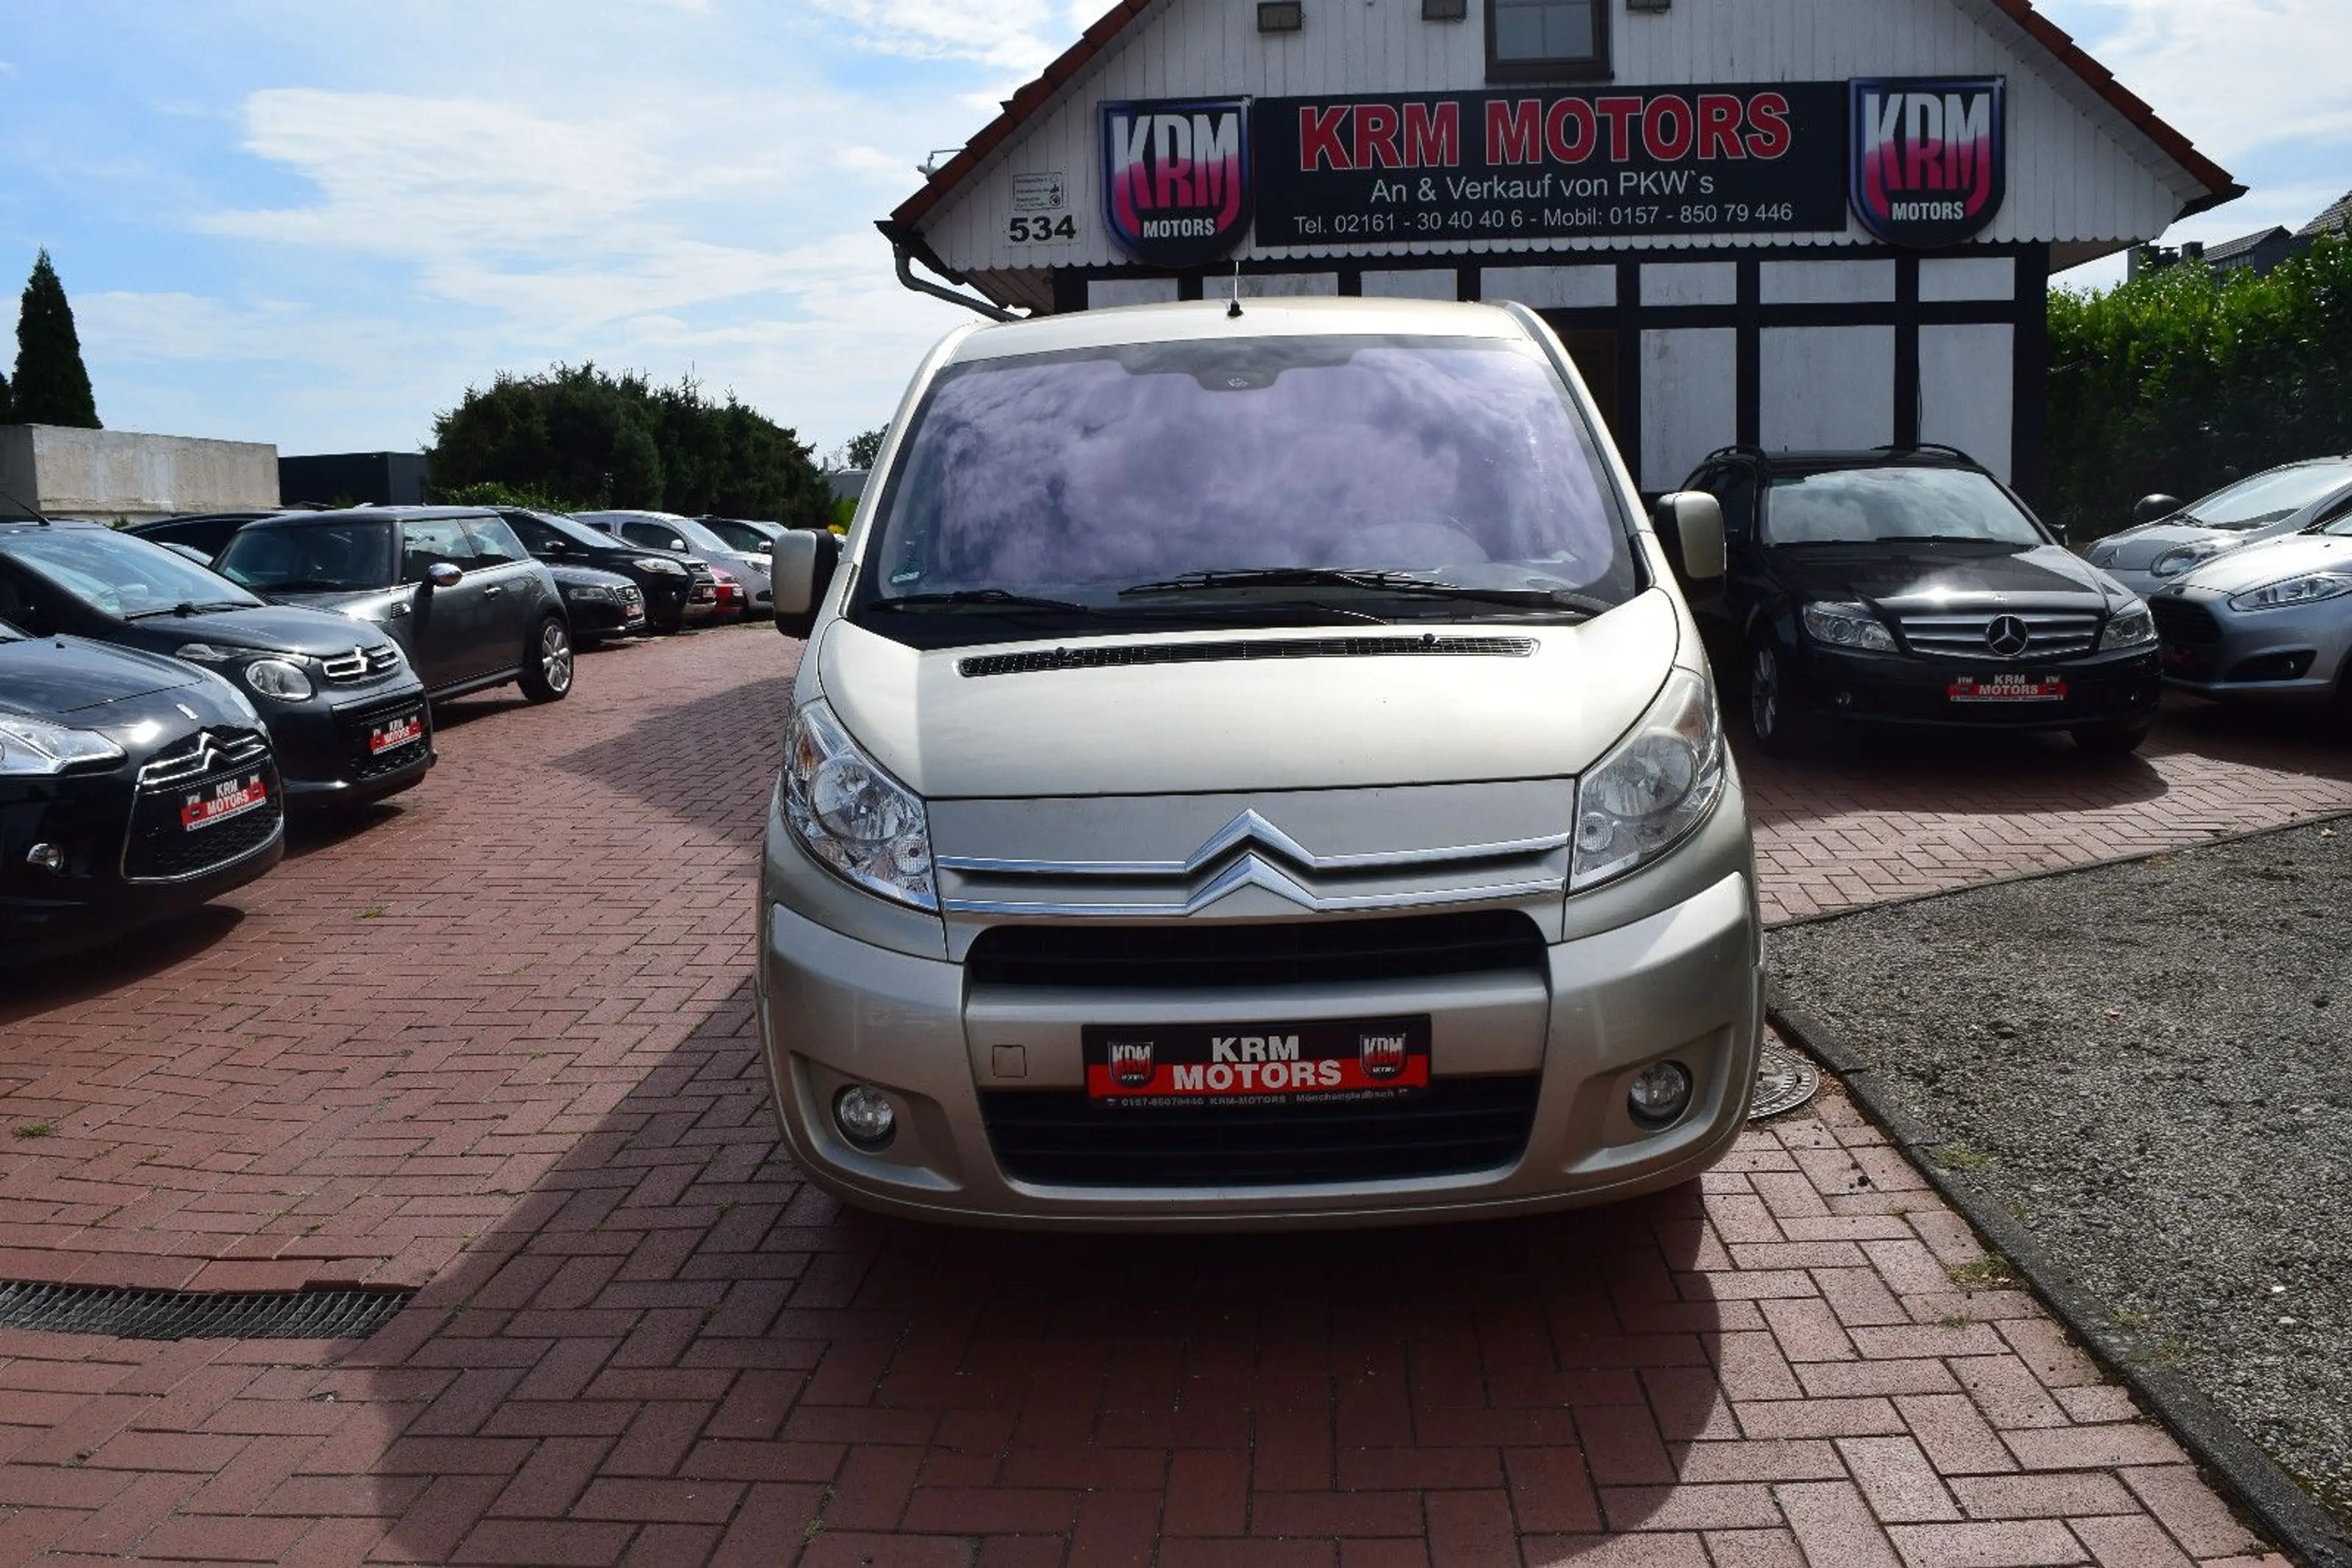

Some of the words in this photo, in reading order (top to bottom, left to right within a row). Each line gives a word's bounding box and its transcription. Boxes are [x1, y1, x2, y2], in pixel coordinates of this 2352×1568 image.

[1299, 101, 1460, 172] KRM
[1485, 92, 1792, 166] MOTORS
[1865, 93, 1990, 218] KRM
[1112, 113, 1241, 235] KRM
[1370, 179, 1407, 203] An
[1418, 177, 1436, 202] &
[1446, 173, 1553, 200] Verkauf
[1559, 178, 1608, 197] von
[1294, 216, 1327, 234] Tel.
[1334, 213, 1394, 233] 02161
[1417, 212, 1442, 230] 30
[1447, 211, 1472, 229] 40
[1479, 209, 1504, 228] 40
[1510, 209, 1523, 227] 6
[1544, 207, 1602, 226] Mobil:
[1610, 206, 1659, 225] 0157
[1679, 205, 1717, 223] 850
[1724, 203, 1749, 222] 79
[1754, 203, 1793, 221] 446
[1891, 201, 1964, 221] MOTORS
[1008, 214, 1077, 243] 534
[1143, 218, 1215, 238] MOTORS
[1979, 685, 2038, 695] MOTORS
[1994, 674, 2025, 684] KRM
[207, 789, 249, 815] MOTORS
[216, 779, 238, 797] KRM
[1212, 1035, 1299, 1062] KRM
[1172, 1060, 1342, 1091] MOTORS
